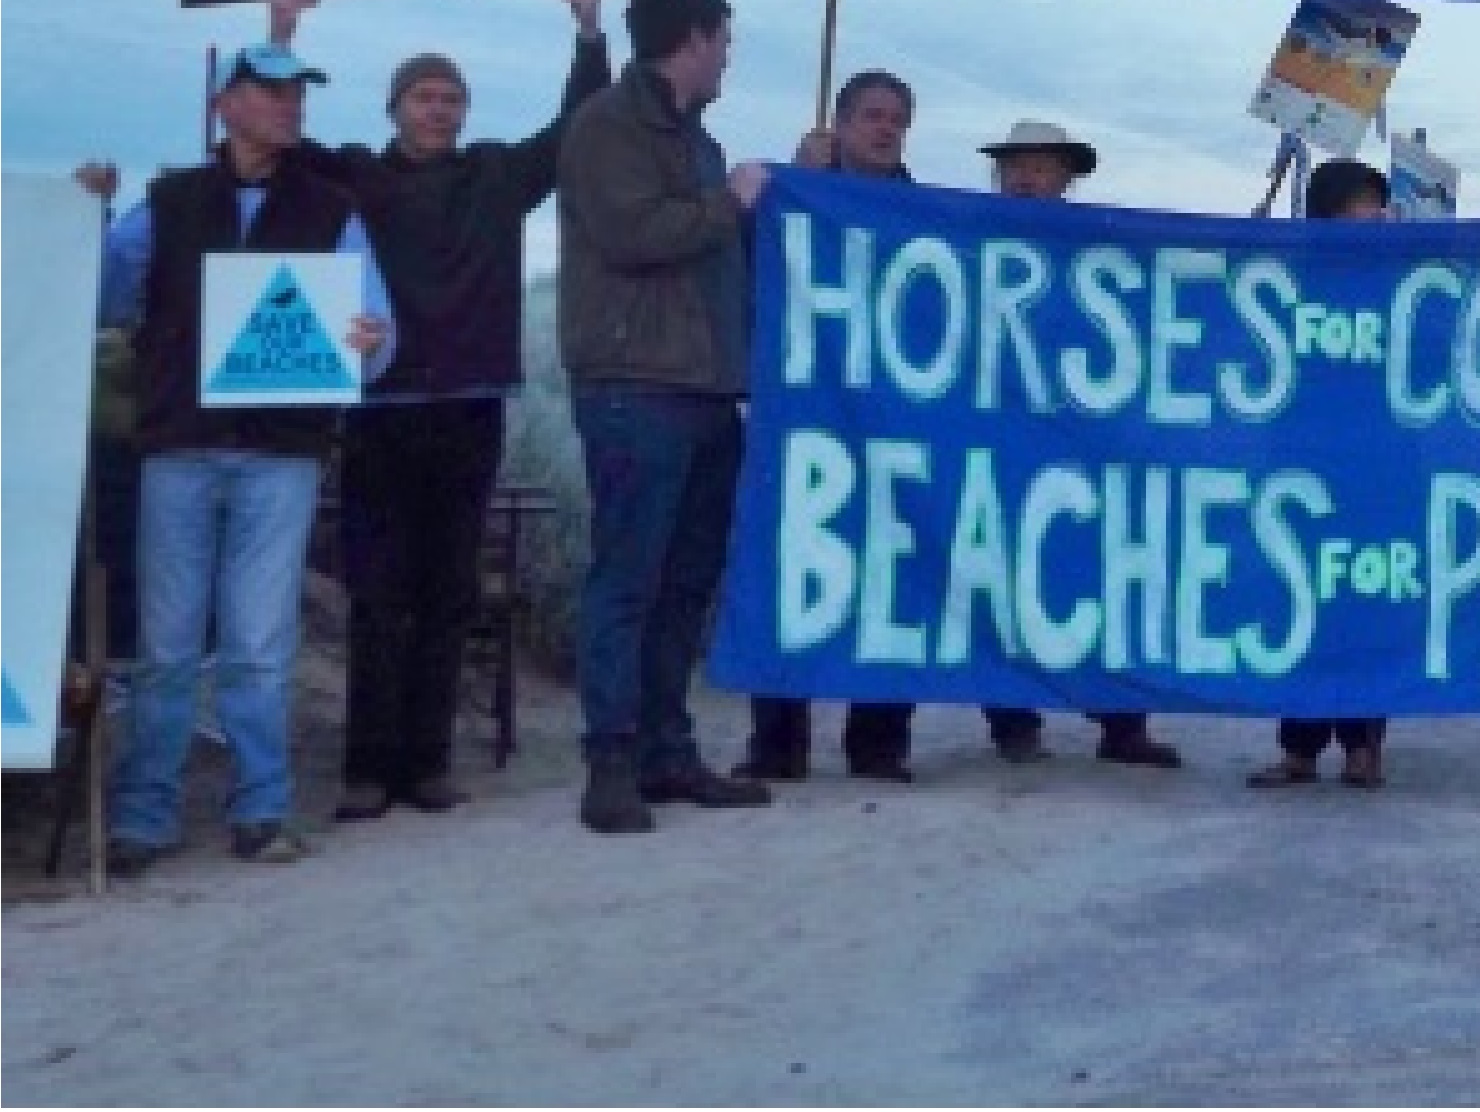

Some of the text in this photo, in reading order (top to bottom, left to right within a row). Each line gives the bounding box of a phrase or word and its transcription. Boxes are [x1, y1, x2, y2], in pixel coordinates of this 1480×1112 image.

[780, 210, 1299, 428] HORSES
[1295, 299, 1388, 366] FOR
[777, 426, 1336, 676] BEACHES
[1315, 536, 1428, 603] FOR
